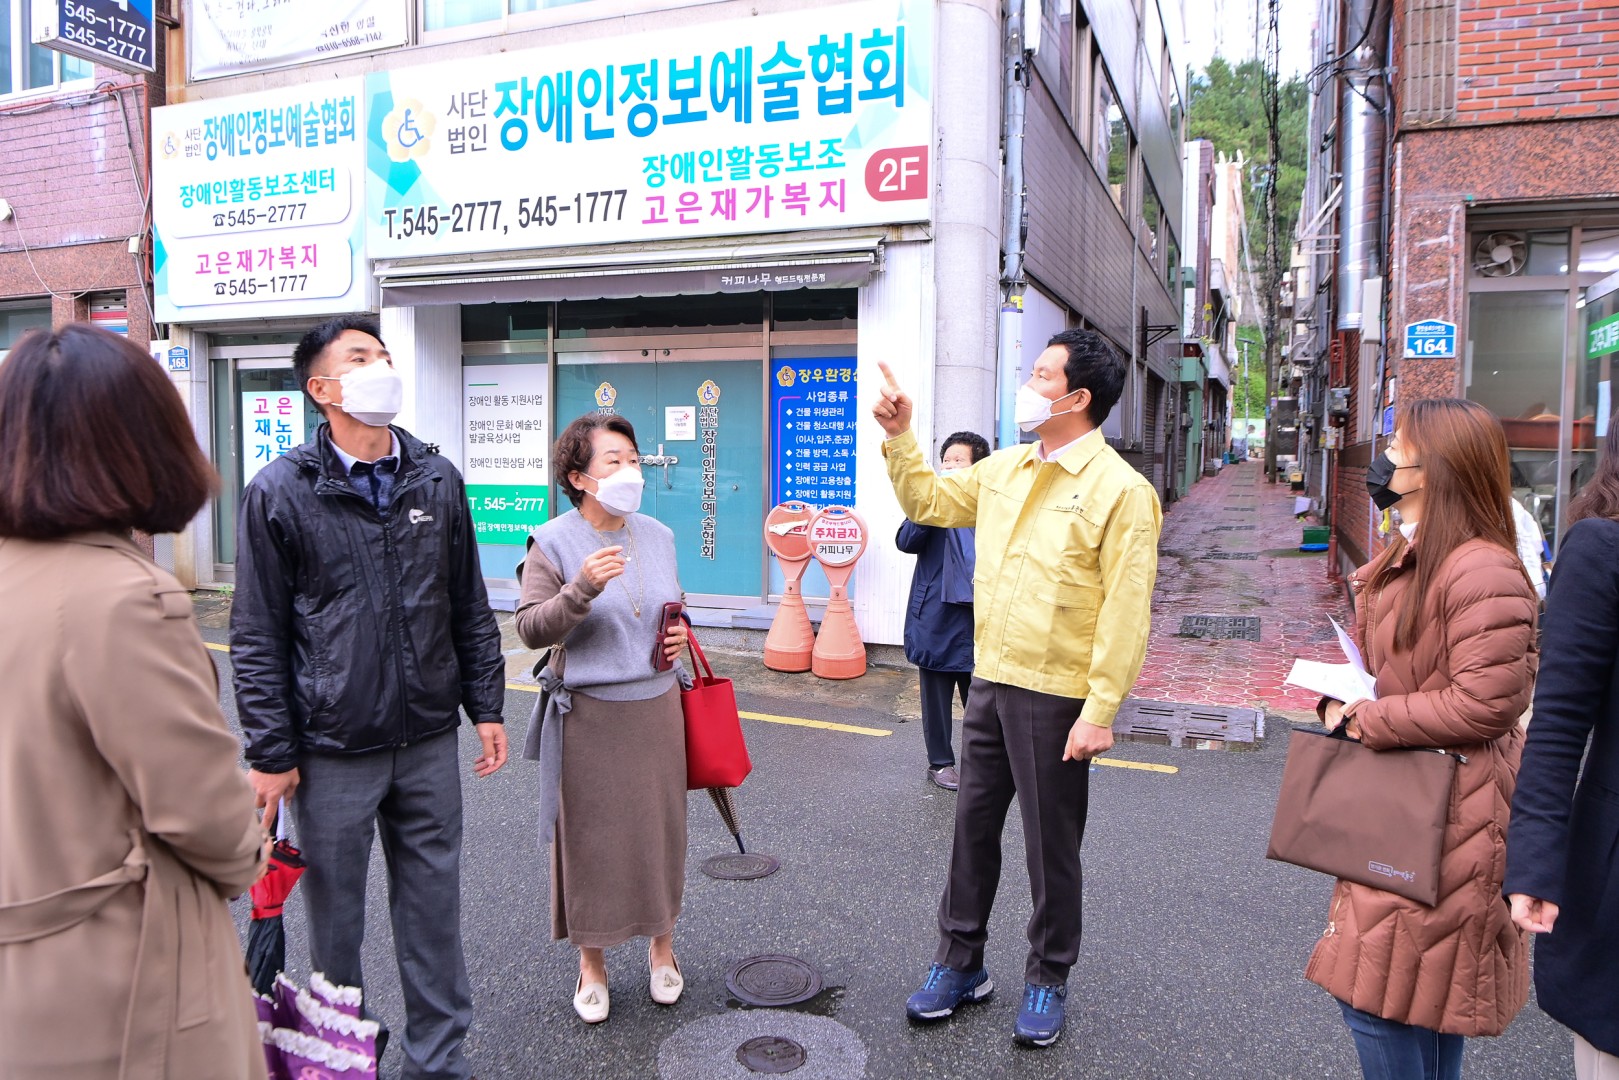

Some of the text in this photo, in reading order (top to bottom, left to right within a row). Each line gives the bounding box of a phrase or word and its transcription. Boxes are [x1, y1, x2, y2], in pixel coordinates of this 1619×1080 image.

[64, 0, 146, 42] 545-1777
[64, 22, 146, 63] 545-2777
[493, 26, 905, 151] 장애인정보예술협회
[447, 89, 488, 119] 사단
[184, 127, 201, 141] 사단
[203, 95, 355, 161] 장애인정보예술협회
[447, 123, 487, 154] 법인
[184, 143, 201, 157] 법인
[642, 138, 846, 188] 장애인활동보조
[878, 156, 920, 192] 2F
[179, 167, 335, 208] 장애인활동보조센터
[518, 189, 628, 228] 545-1777
[641, 178, 846, 225] 고은재가복지
[227, 203, 308, 227] 545-2777
[194, 243, 318, 275] 고은재가복지
[228, 274, 308, 296] 545-1777
[721, 273, 771, 286] 커피나무
[1413, 338, 1448, 354] 164
[171, 358, 187, 368] 168
[468, 394, 543, 407] 장애인 활동 지원사업
[806, 390, 849, 403] 사업종류
[699, 406, 718, 418] 사단
[795, 407, 845, 417] 건물 위생관리
[468, 420, 495, 432] 장애인
[515, 419, 542, 431] 예술인
[699, 417, 718, 428] 법인
[795, 421, 857, 431] 건물 청소대행 사
[275, 418, 293, 456] 노인
[468, 432, 521, 444] 발굴육성사업
[795, 448, 811, 458] 건물
[833, 448, 849, 458] 소독
[469, 457, 543, 469] 장애인 민원상담 사업
[795, 462, 846, 472] 인력 공급 사업
[795, 476, 818, 485] 장애인
[820, 476, 852, 486] 고용창출
[701, 429, 717, 560] 장애인정보예술협회
[795, 489, 852, 500] 장애인 활동지원
[815, 527, 858, 539] 주차금지
[819, 545, 854, 555] 커피나무
